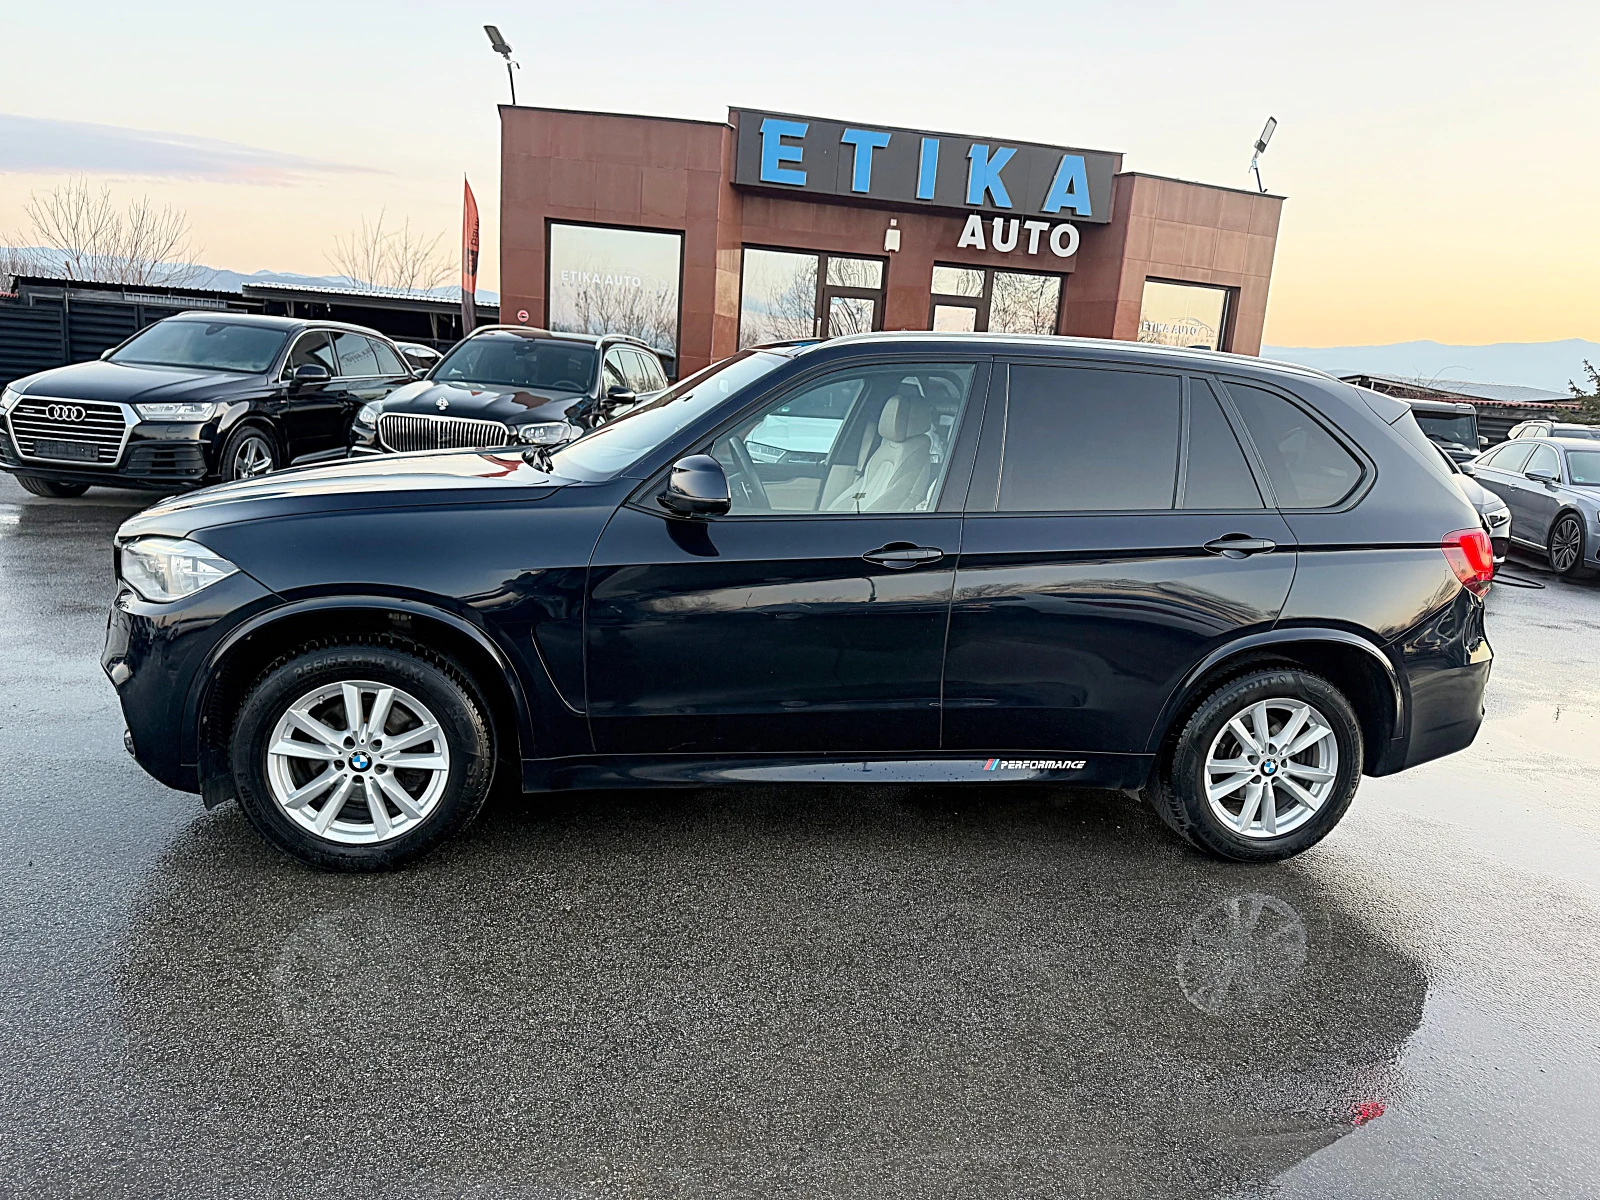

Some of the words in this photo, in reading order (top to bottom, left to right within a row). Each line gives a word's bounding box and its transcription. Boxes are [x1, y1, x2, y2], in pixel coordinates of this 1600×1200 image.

[760, 117, 1092, 216] ETIKA
[957, 214, 1080, 258] AUTO
[561, 270, 600, 284] ETIKA
[605, 274, 641, 287] AUTO
[1142, 321, 1169, 334] ETIKA
[1171, 324, 1197, 336] AUTO
[1000, 760, 1087, 770] PERFORMANCE
